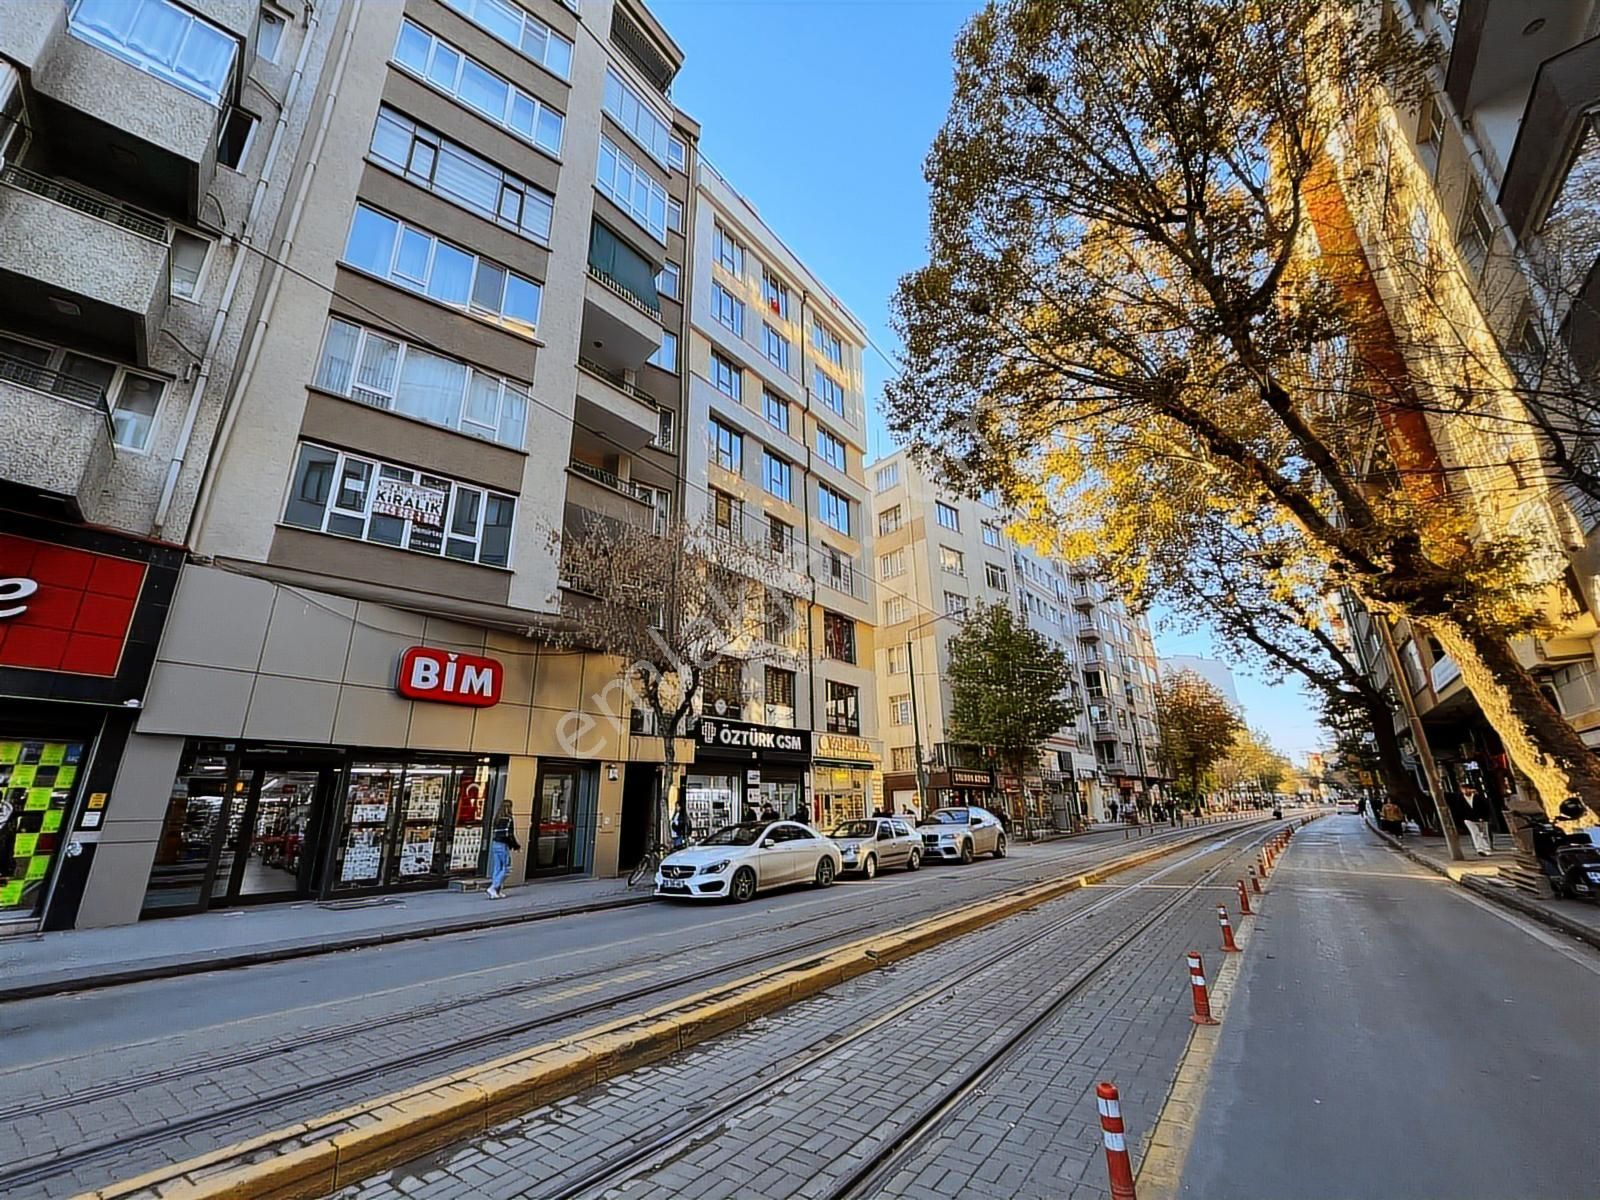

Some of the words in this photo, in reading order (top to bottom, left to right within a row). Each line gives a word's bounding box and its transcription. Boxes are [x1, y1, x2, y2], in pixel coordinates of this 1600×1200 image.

[411, 653, 493, 697] BİM
[719, 724, 775, 749] ÖZTÜRK
[776, 733, 802, 751] GSM
